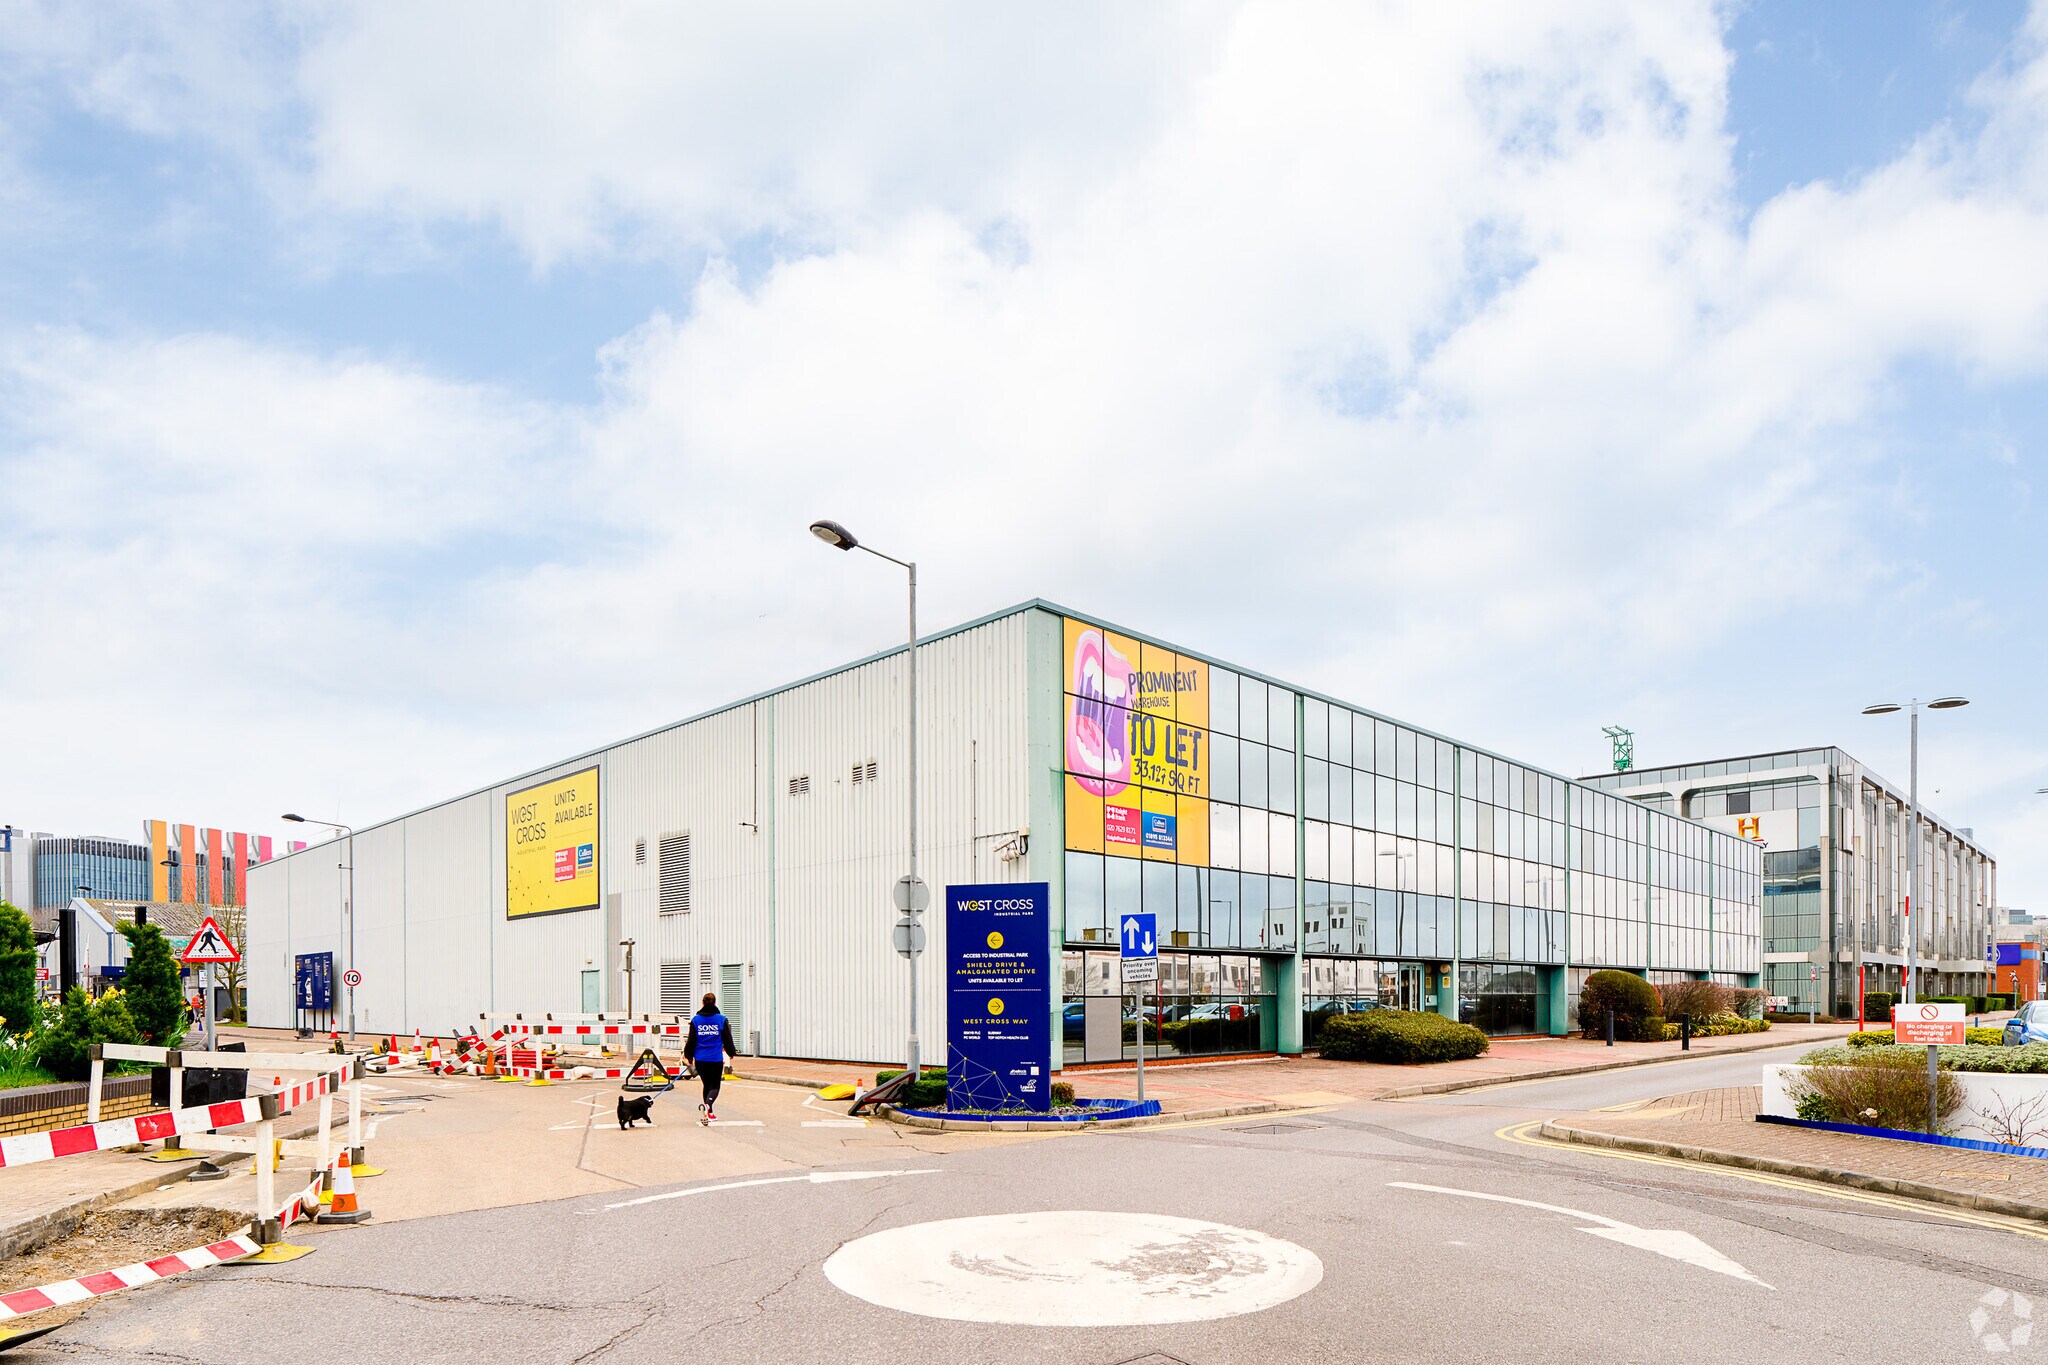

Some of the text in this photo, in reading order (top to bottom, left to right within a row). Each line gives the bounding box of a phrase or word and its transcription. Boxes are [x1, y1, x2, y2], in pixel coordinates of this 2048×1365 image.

[1128, 669, 1197, 695] PROMINENT
[1131, 696, 1170, 709] WAREHOUSE
[1127, 713, 1202, 771] TO LET
[1169, 769, 1185, 792] SQ
[1188, 775, 1200, 794] FT
[554, 789, 576, 806] UNITS
[511, 802, 538, 825] WEST
[554, 803, 593, 824] AVAILABLE
[516, 821, 547, 845] CROSS
[1736, 816, 1761, 839] H
[957, 899, 1034, 911] WEST CROSS
[347, 974, 359, 983] 10
